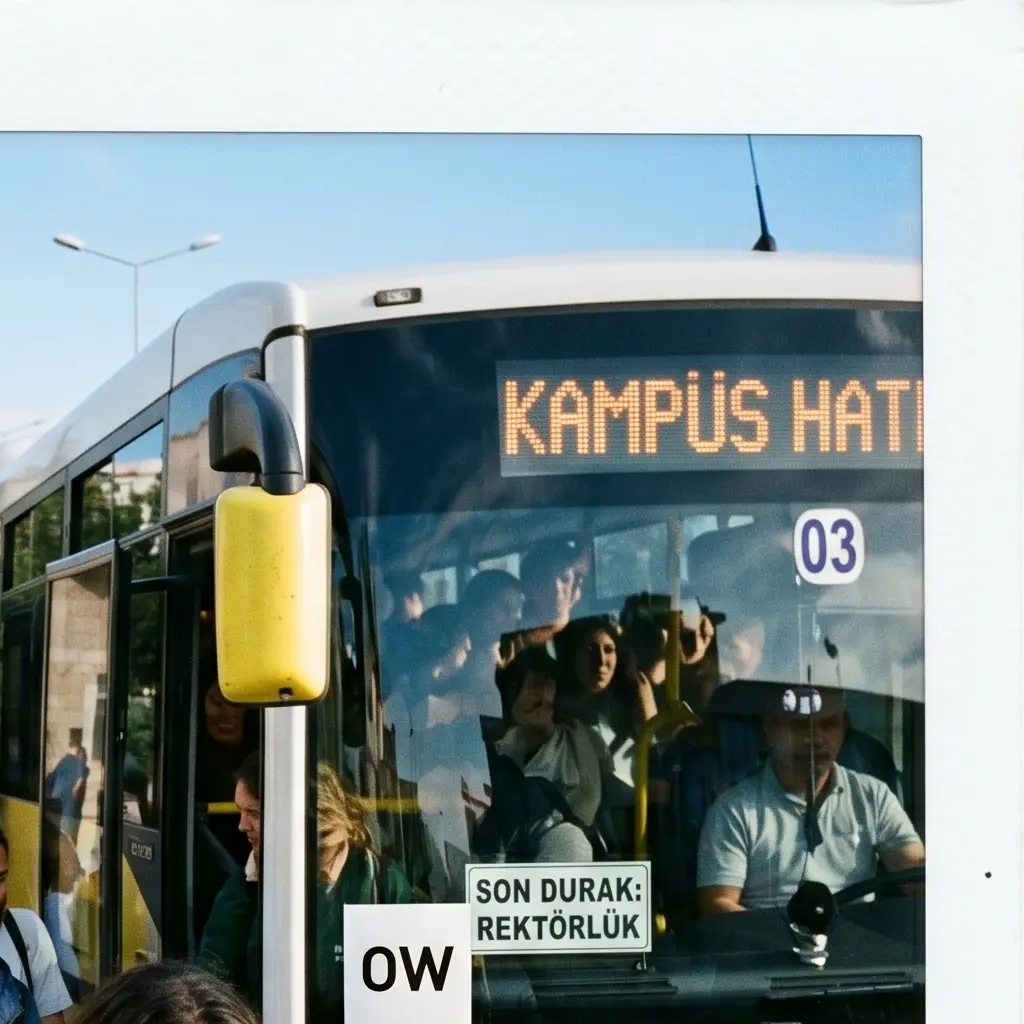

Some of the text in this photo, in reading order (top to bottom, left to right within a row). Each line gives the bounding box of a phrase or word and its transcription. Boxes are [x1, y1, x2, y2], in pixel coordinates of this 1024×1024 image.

[504, 371, 771, 455] KAMPÜS
[800, 517, 857, 574] 03
[476, 877, 642, 904] SON DURAK:
[477, 908, 641, 941] REKTÖRLÜK
[362, 945, 454, 992] OW
